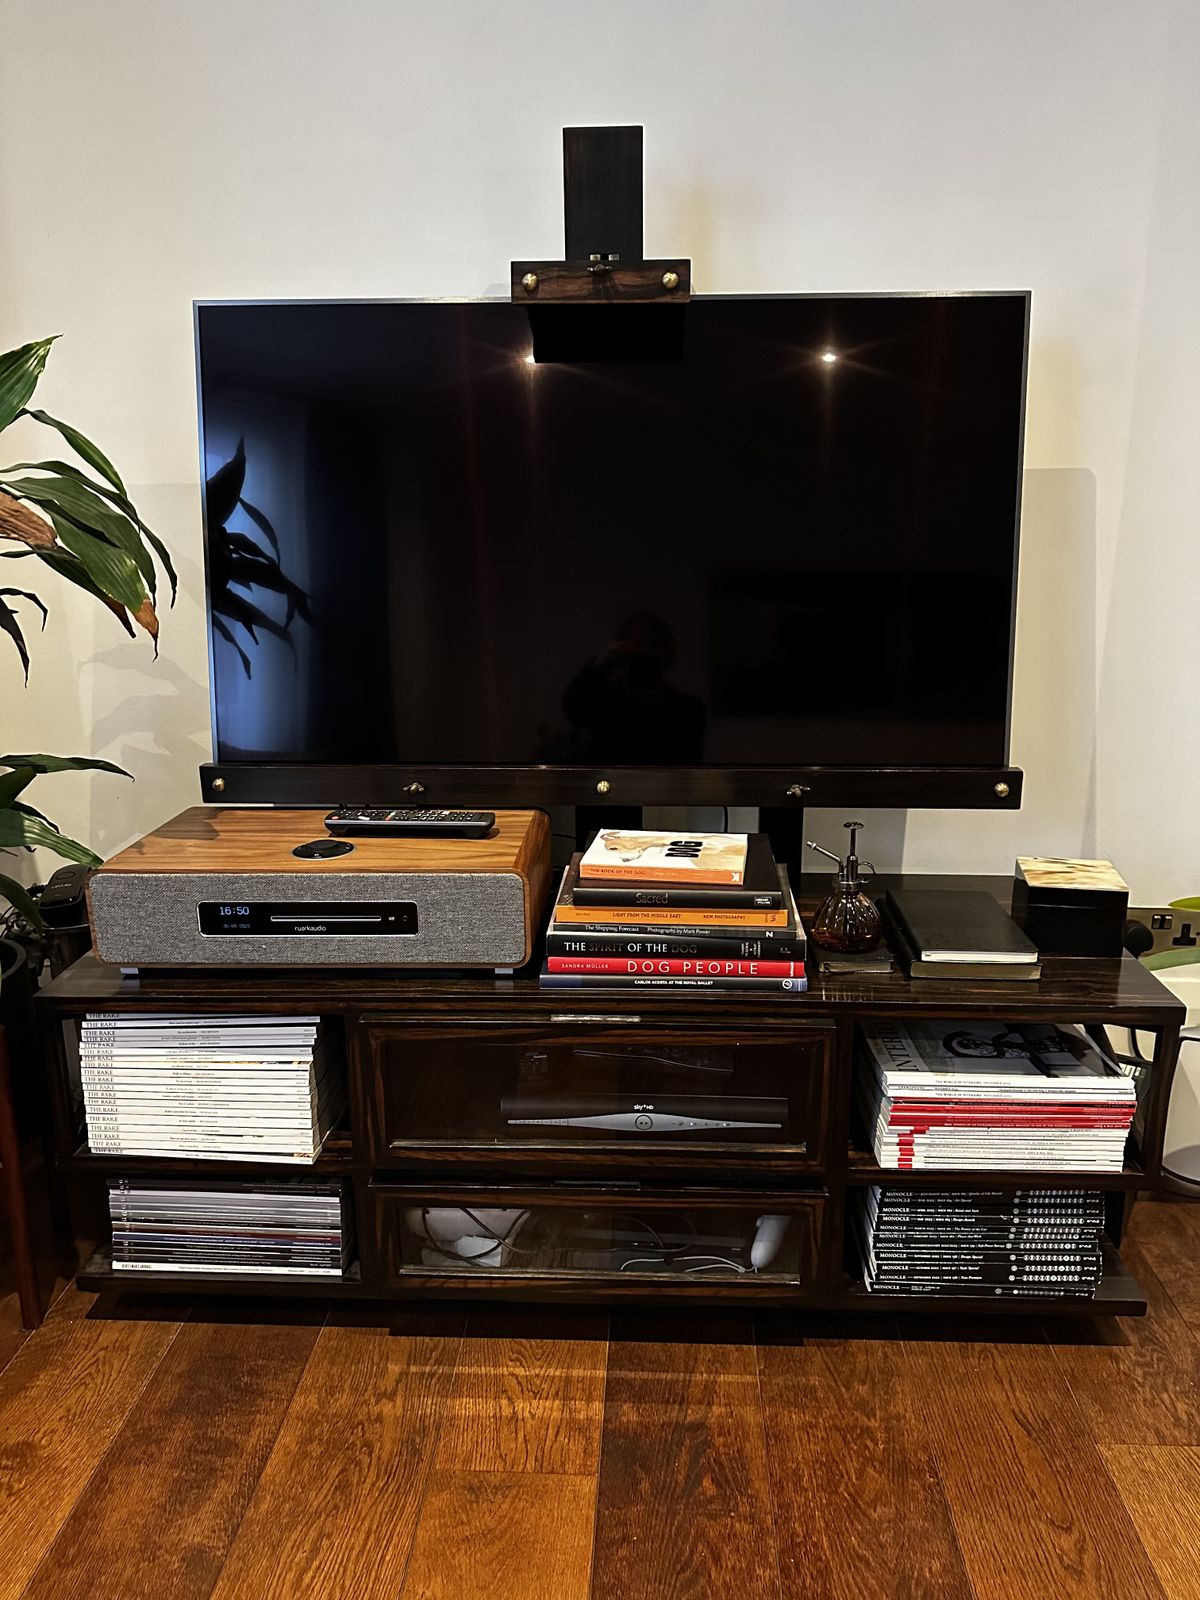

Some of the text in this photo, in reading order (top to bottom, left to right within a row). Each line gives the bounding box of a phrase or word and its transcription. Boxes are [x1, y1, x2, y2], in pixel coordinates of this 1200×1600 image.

[665, 840, 703, 858] DOG
[635, 892, 668, 904] Sacred
[220, 906, 250, 916] 16:50
[563, 942, 697, 953] THE SPIRIT OF THE DOG
[626, 960, 759, 975] DOG PEOPLE
